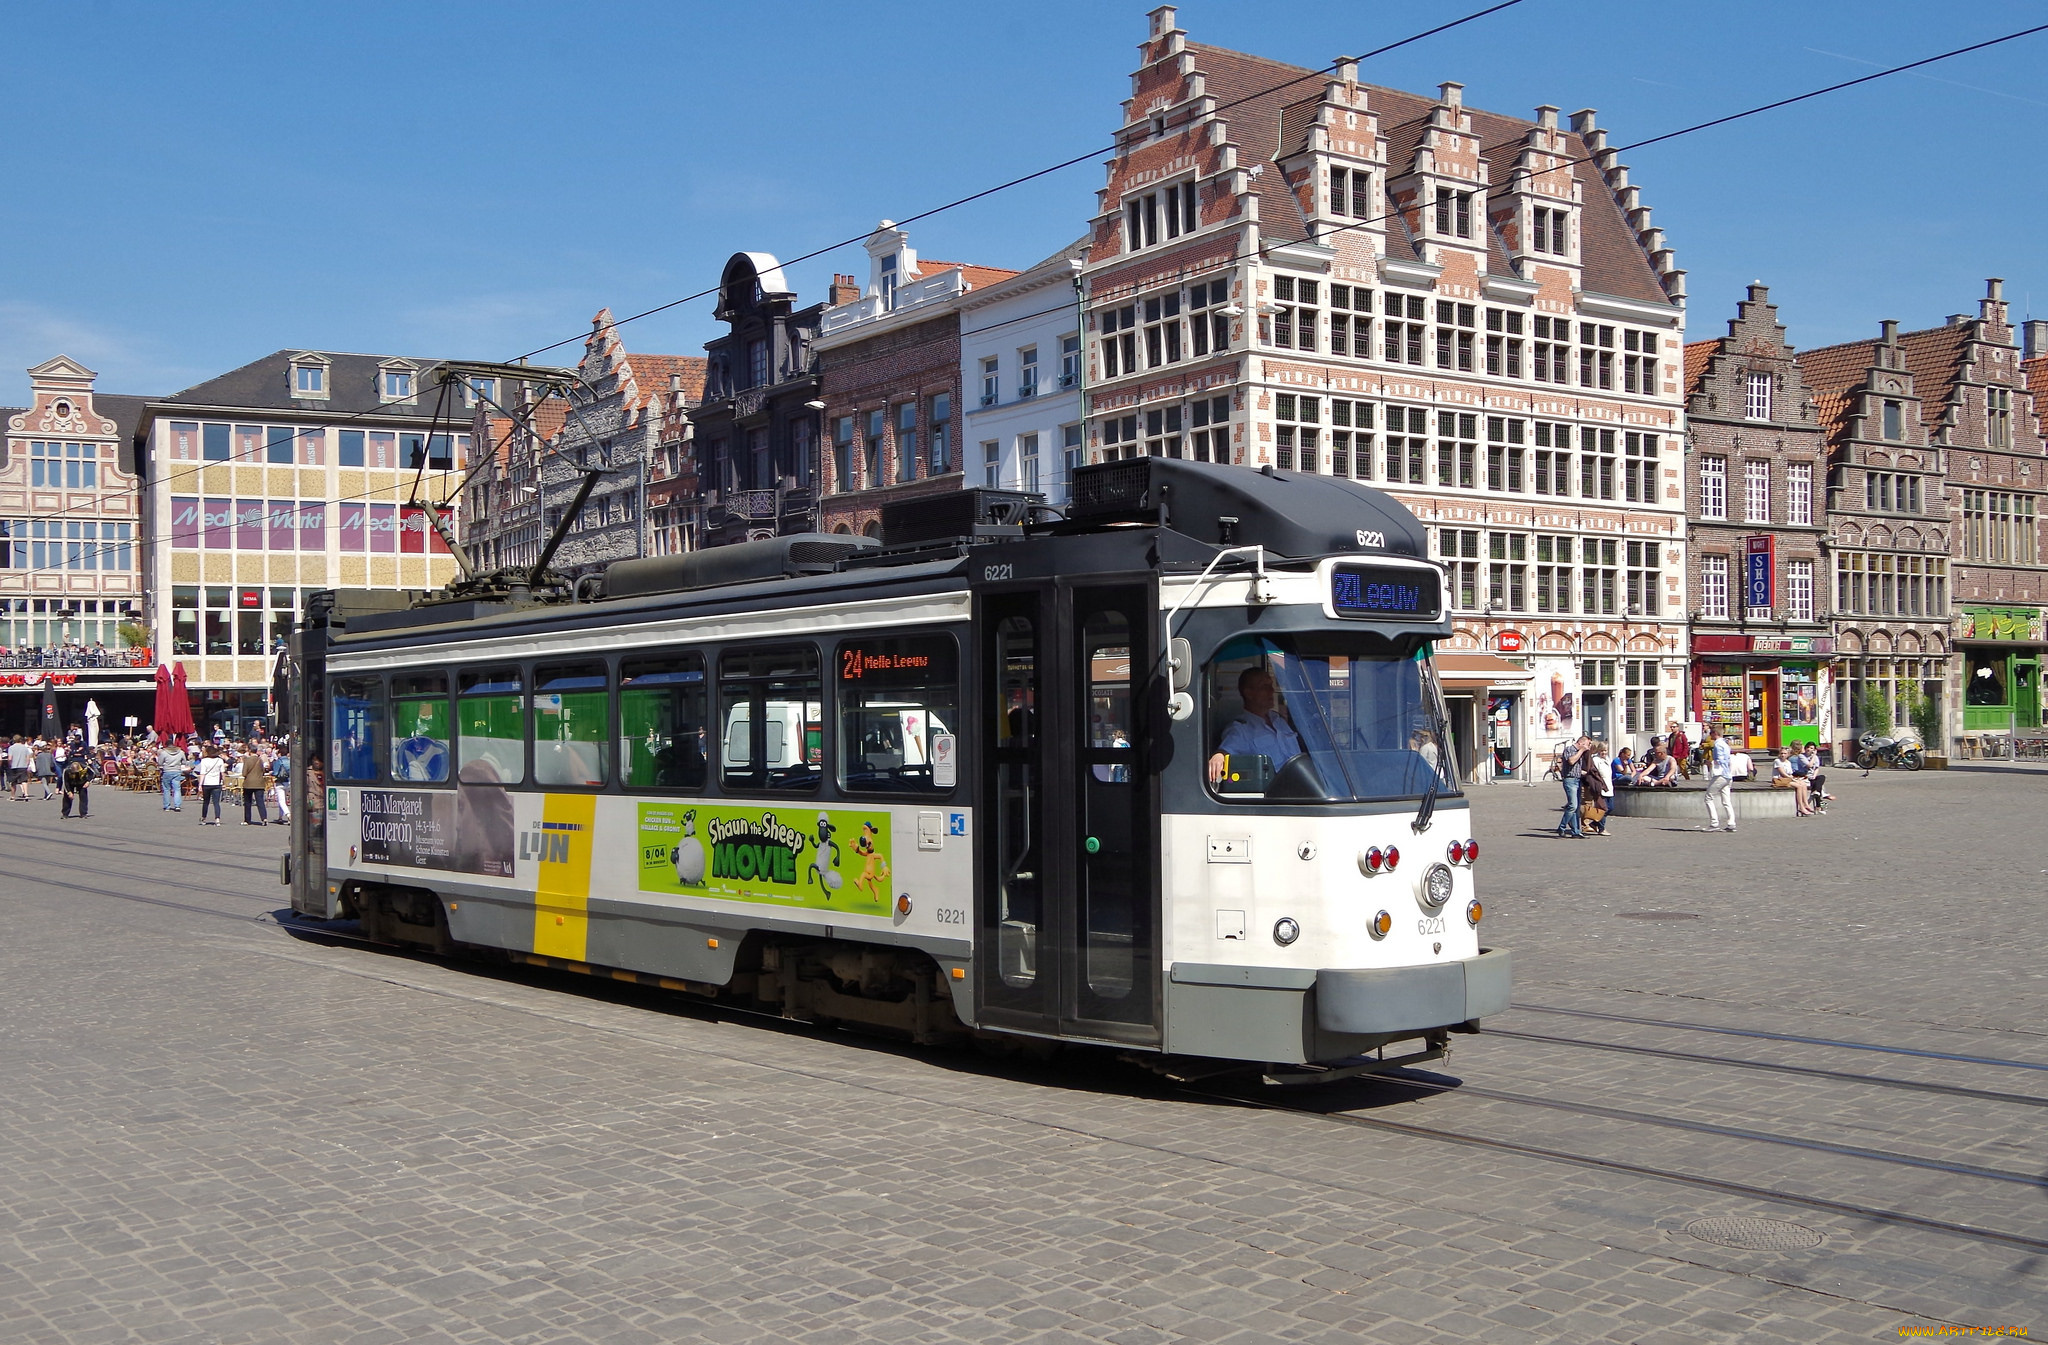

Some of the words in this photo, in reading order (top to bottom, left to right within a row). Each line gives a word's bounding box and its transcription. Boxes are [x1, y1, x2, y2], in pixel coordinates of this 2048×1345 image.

[173, 506, 244, 527] Media
[268, 509, 323, 529] Markt
[341, 511, 407, 532] Media
[1356, 529, 1385, 548] 6221
[984, 563, 1013, 581] 6221
[1753, 555, 1765, 604] SHOP
[1357, 574, 1419, 610] Leeuw
[843, 649, 863, 679] 24
[864, 655, 891, 669] Melle
[893, 654, 928, 668] Leeuw
[0, 674, 25, 685] edia
[361, 793, 381, 813] Julia
[383, 794, 423, 821] Margaret
[362, 814, 412, 850] Cameron
[532, 821, 541, 829] DE
[708, 817, 749, 845] Shaun
[750, 822, 762, 835] the
[762, 812, 803, 855] Sheep
[645, 847, 665, 860] 8/04
[713, 842, 796, 883] MOVIE
[936, 908, 965, 925] 6221
[1417, 916, 1446, 936] 6221
